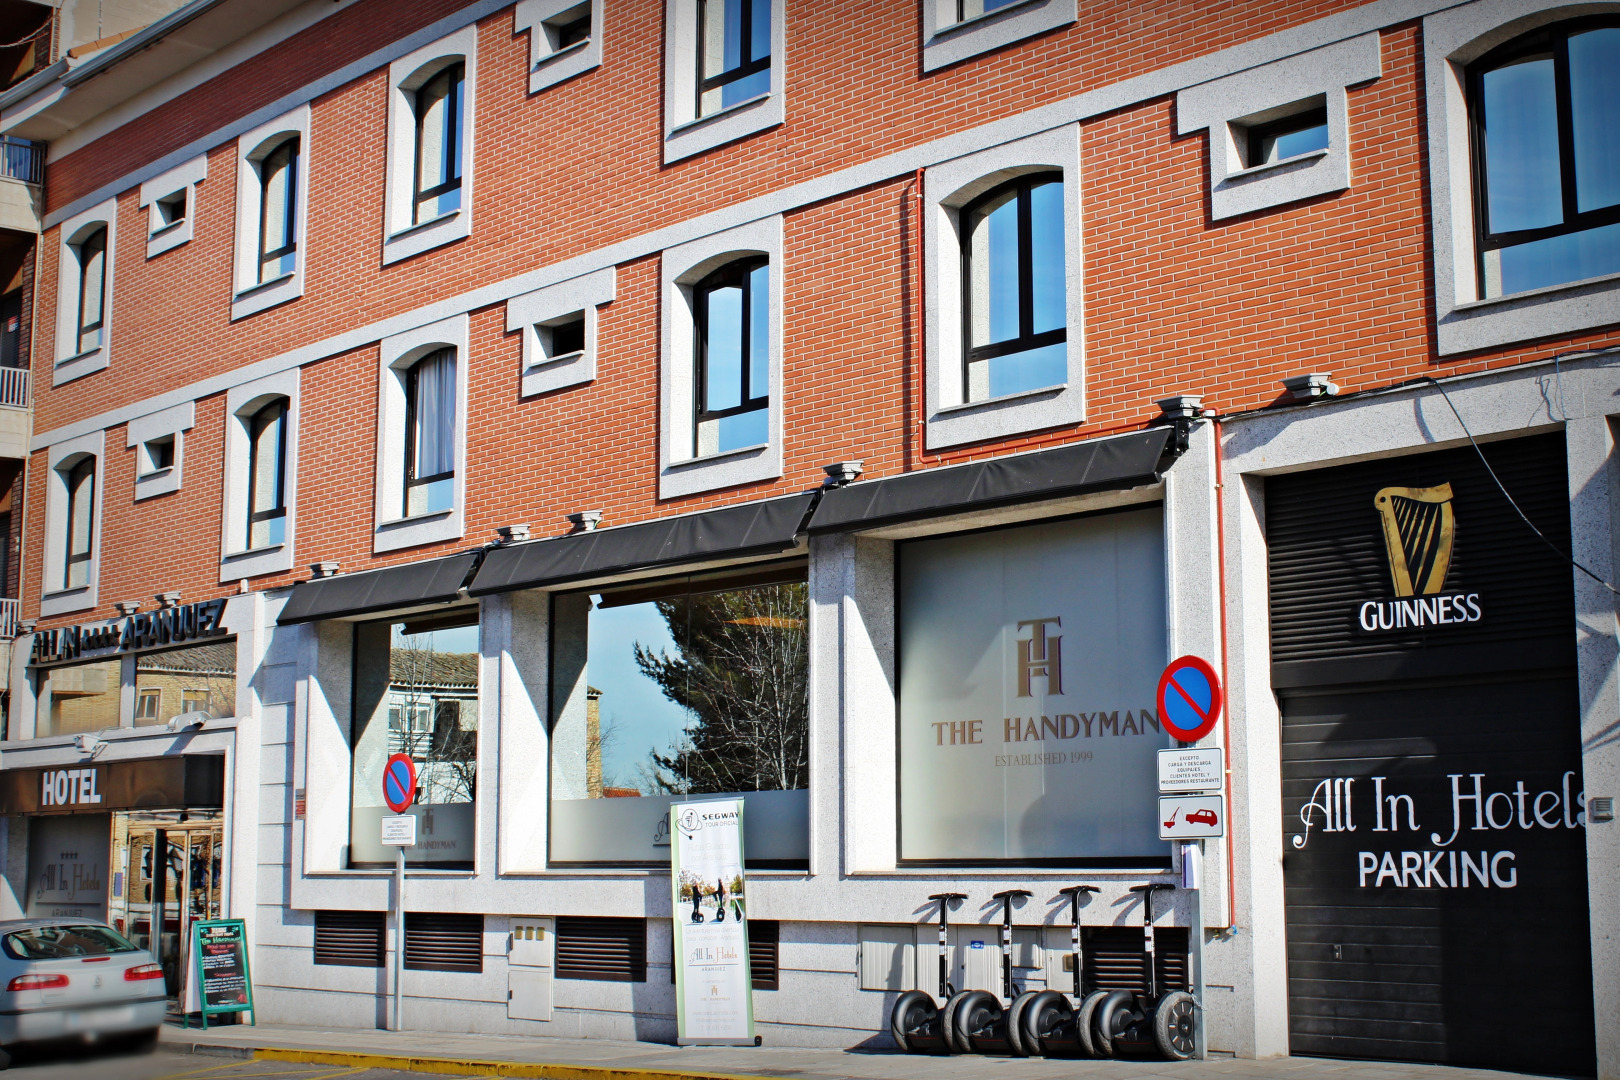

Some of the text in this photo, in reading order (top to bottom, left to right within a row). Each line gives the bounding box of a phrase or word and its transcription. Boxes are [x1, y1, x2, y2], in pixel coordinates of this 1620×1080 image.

[1360, 592, 1482, 631] GUINNESS
[931, 708, 1160, 746] THE HANDYMAN
[994, 751, 1093, 767] ESTABLISHED 1999
[42, 768, 101, 806] HOTEL
[702, 811, 740, 820] SEGWAY
[1293, 777, 1357, 849] All
[1371, 776, 1421, 832] In
[418, 840, 456, 850] HANDYMAN
[1358, 850, 1518, 888] PARKING
[706, 947, 713, 960] In
